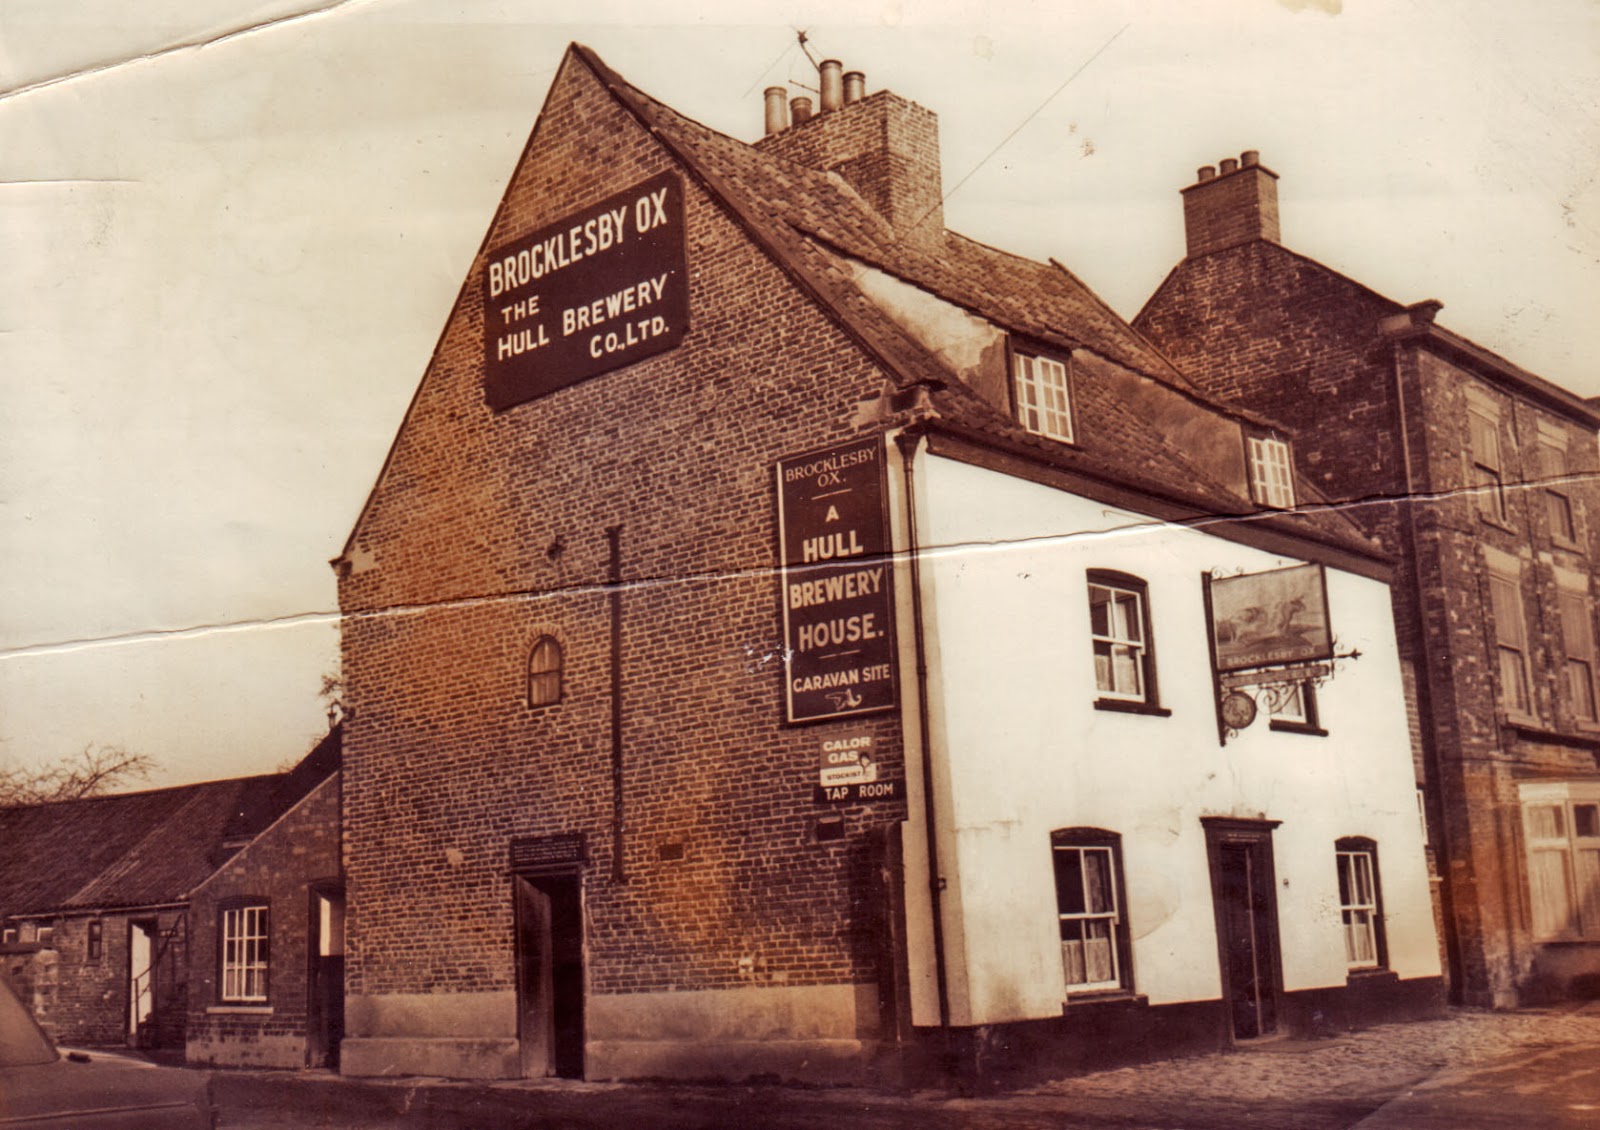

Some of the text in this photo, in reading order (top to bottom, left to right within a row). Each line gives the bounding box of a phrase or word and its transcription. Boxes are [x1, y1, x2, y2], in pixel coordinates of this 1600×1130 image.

[489, 187, 668, 297] BROCKLESBY OX
[498, 273, 668, 361] HULL BREWERY
[501, 295, 540, 324] THE
[785, 446, 877, 482] BROCKLESBY
[825, 505, 840, 523] A
[803, 530, 864, 563] HULL
[789, 567, 883, 609] BREWERY
[799, 613, 884, 653] HOUSE.
[1227, 647, 1315, 666] BROCKLESBY OX
[793, 664, 891, 692] CARAVAN SITE
[823, 736, 871, 751] CALOR
[828, 750, 859, 764] GAS
[824, 783, 894, 800] TAP ROOM
